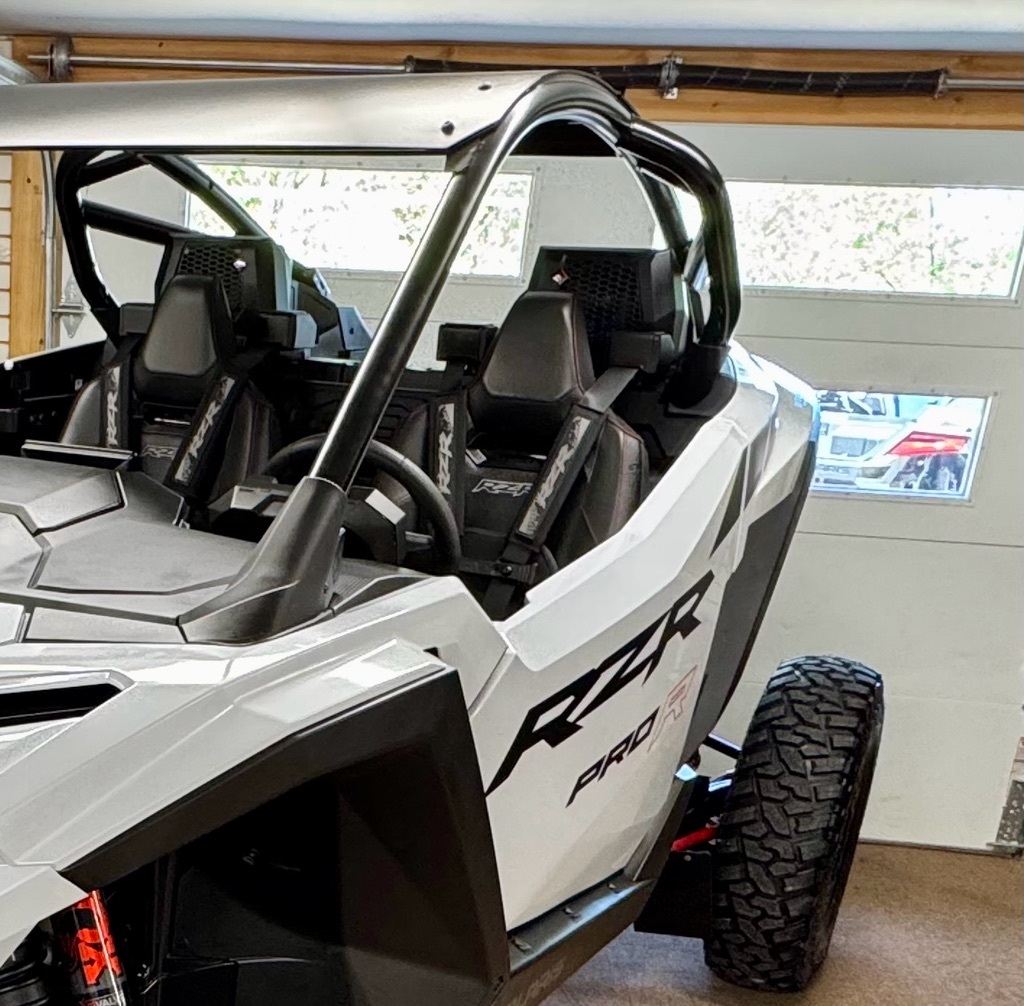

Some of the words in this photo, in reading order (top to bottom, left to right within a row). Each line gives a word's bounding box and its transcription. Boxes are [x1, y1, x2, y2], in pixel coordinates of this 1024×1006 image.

[140, 444, 179, 460] RZ
[535, 443, 575, 509] RZR
[485, 569, 715, 797] RZR
[565, 705, 661, 808] PRO
